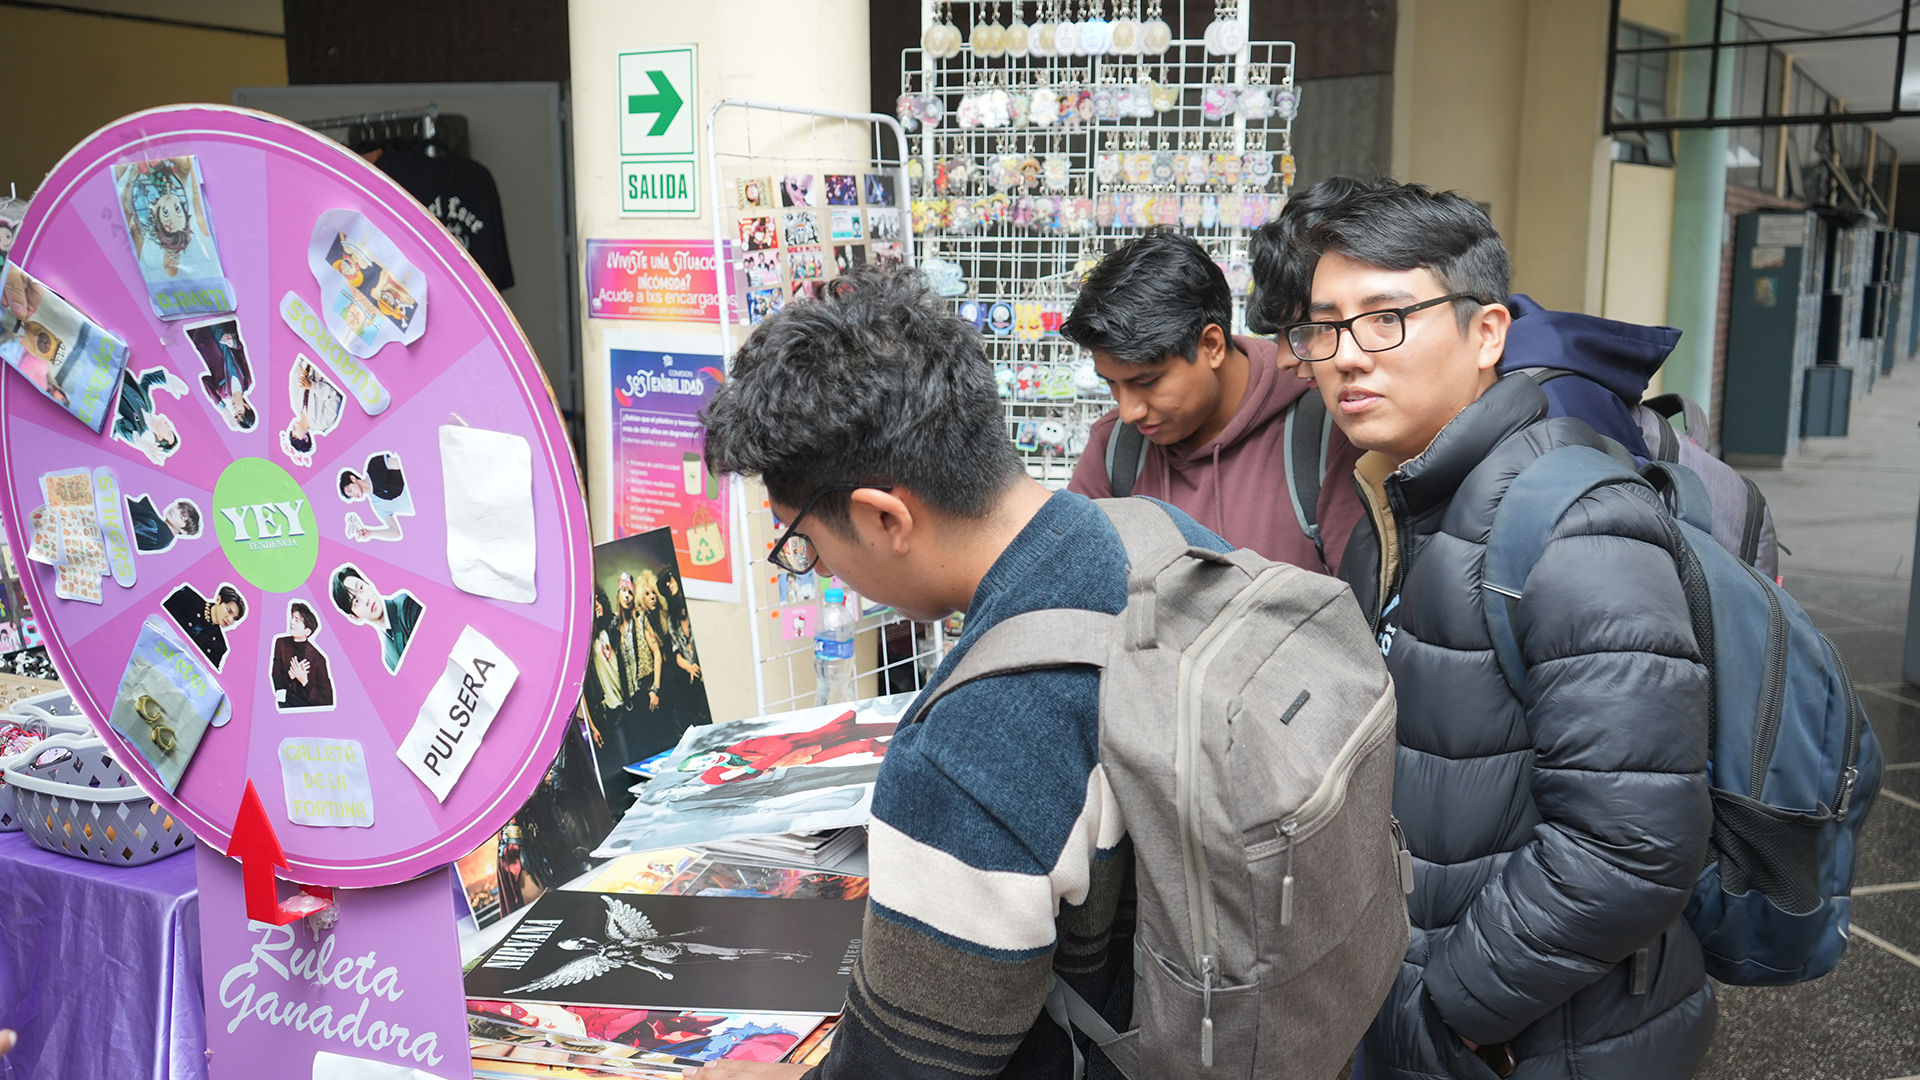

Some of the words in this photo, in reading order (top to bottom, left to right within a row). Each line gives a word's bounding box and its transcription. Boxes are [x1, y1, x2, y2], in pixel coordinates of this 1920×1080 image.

[628, 173, 688, 199] SALIDA
[650, 251, 670, 270] UNA
[668, 250, 717, 276] SITUACIÓ
[599, 287, 634, 303] Acude
[636, 291, 645, 304] a
[665, 291, 740, 309] encargas,
[287, 300, 380, 405] CUADROS
[621, 369, 704, 398] SOSTENIBILIDAD
[98, 476, 132, 577] STIKERS
[220, 499, 306, 542] YEY
[247, 538, 298, 551] TENDENCIA
[155, 641, 207, 697] aretes
[423, 658, 496, 777] PULSERA
[285, 745, 356, 763] GALLETA
[303, 772, 326, 790] DE
[327, 772, 348, 791] LA
[293, 799, 367, 819] FORTUNA
[481, 918, 564, 971] NIRVANA
[841, 938, 862, 964] UTERO
[247, 919, 405, 1003] Ruleta
[836, 966, 853, 975] IN
[219, 962, 444, 1067] Ganadora
